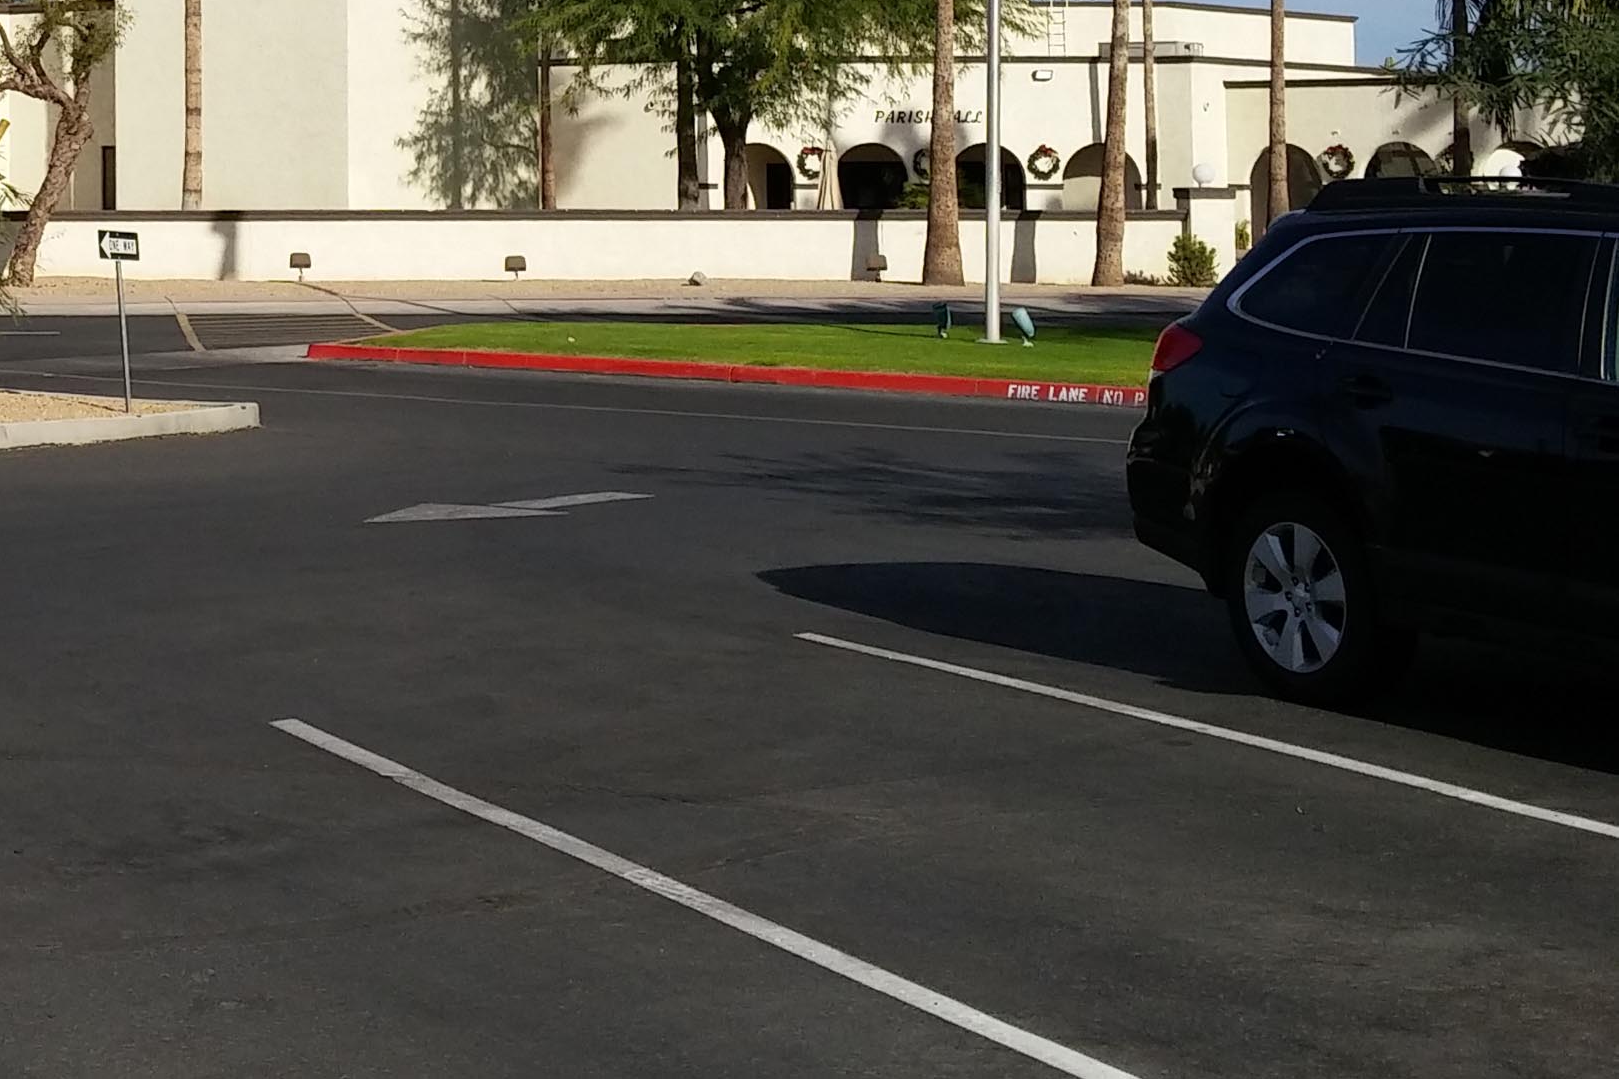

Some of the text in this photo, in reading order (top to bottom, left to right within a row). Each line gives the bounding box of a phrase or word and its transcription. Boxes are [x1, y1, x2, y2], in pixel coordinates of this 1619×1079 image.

[953, 110, 983, 124] ALL
[108, 239, 120, 252] ONE
[1007, 384, 1041, 400] FIRE
[1048, 386, 1088, 403] LANE
[1102, 389, 1124, 405] NO
